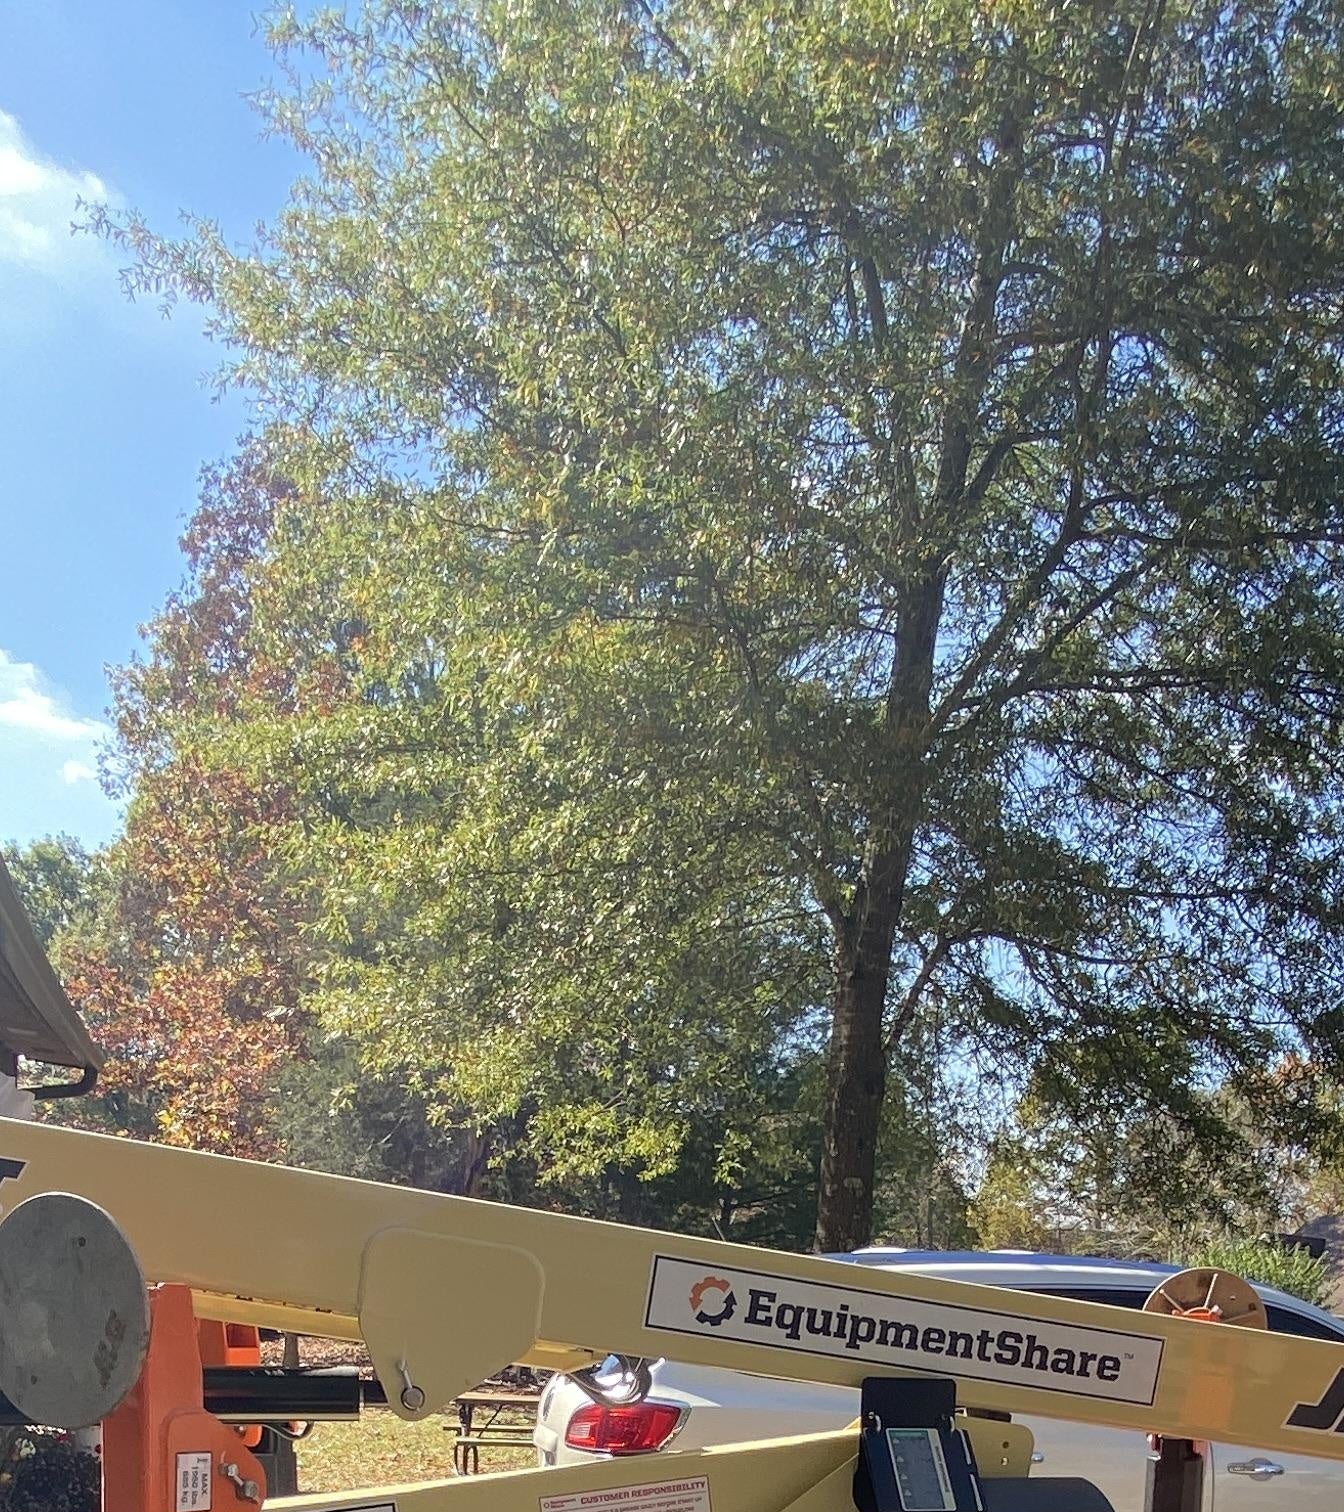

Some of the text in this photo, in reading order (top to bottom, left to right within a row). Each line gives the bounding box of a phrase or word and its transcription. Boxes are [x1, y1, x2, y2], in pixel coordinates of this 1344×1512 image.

[744, 1289, 1122, 1382] EquipmentShare
[581, 1491, 630, 1504] CUSTOMER
[631, 1481, 706, 1498] RESPONSIBILITY
